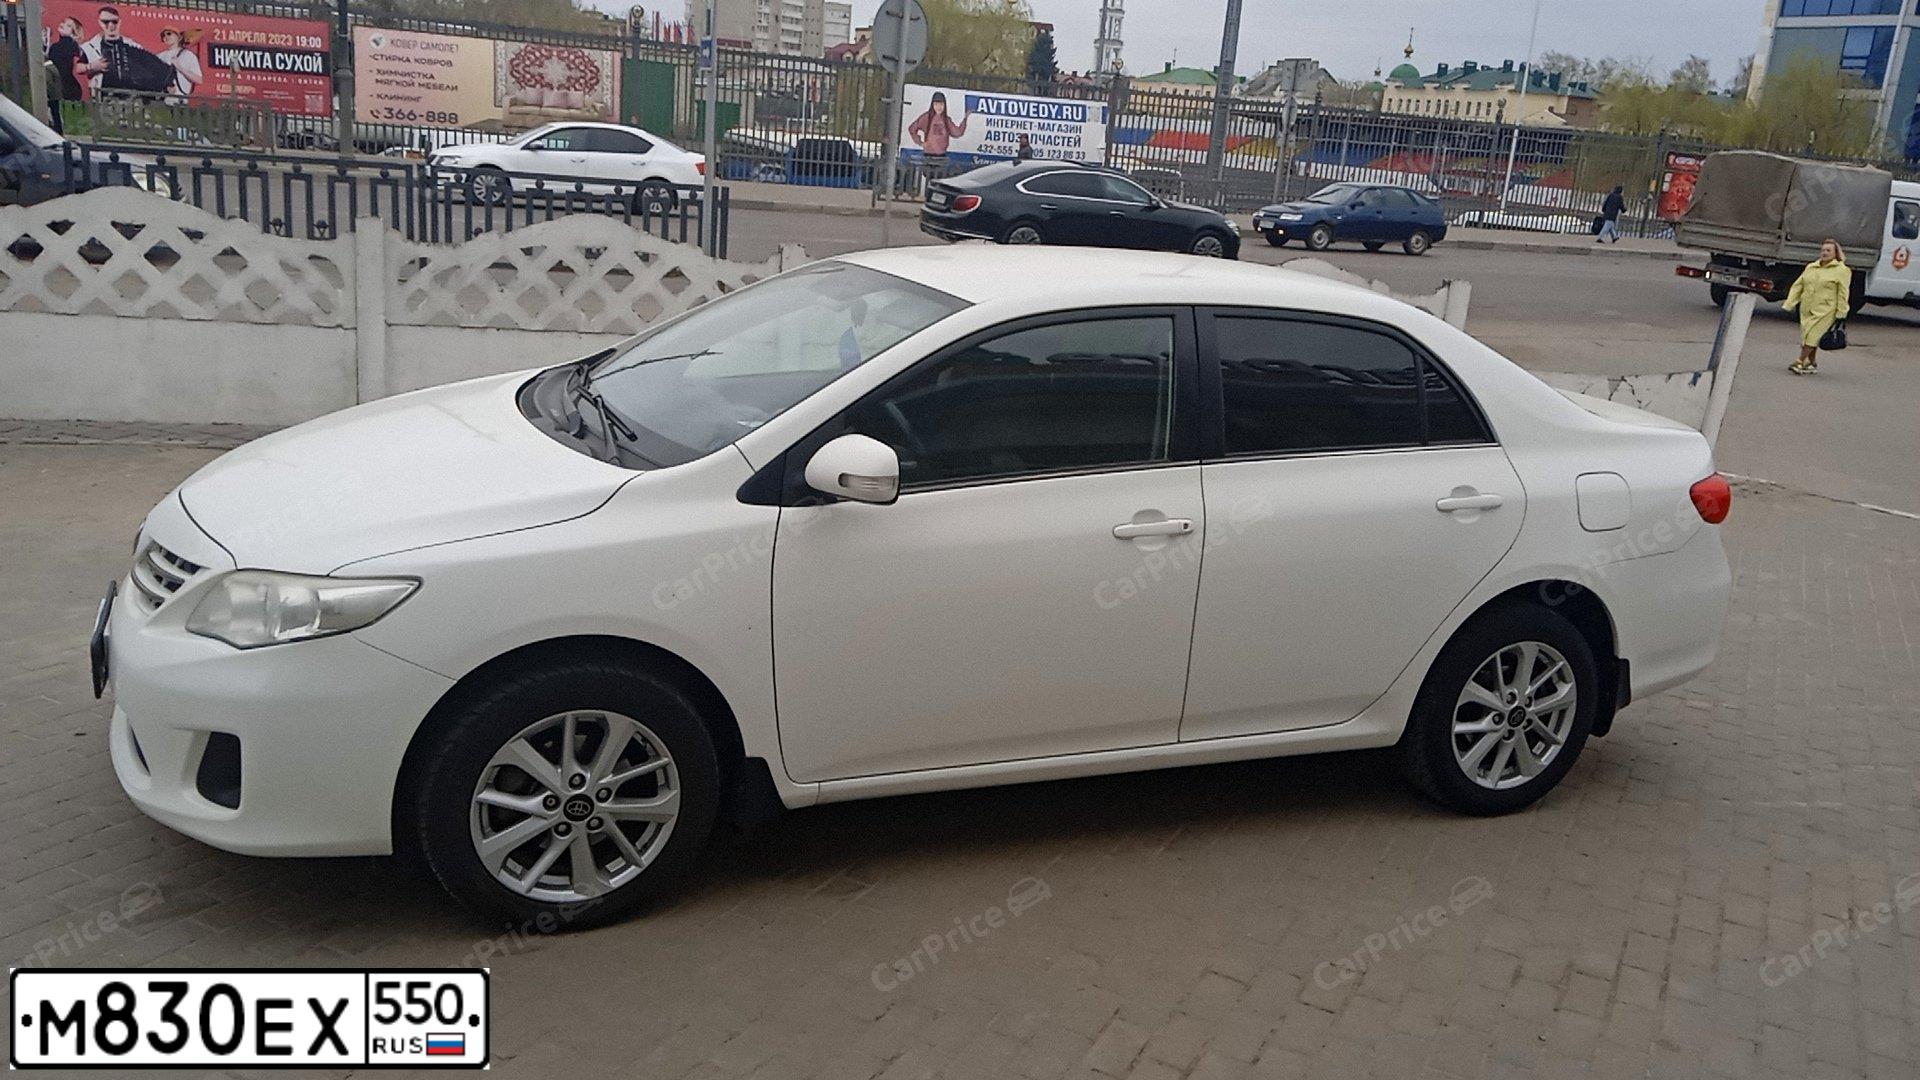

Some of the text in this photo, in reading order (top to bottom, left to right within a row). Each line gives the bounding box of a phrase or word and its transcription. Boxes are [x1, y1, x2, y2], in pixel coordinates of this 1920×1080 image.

[214, 28, 322, 48] 21 АПРЕЛЯ 2023 19:00
[390, 39, 417, 50] КОВЕР
[214, 47, 323, 73] НИКИТА СУХОЙ
[414, 58, 453, 67] КОВРОВ
[376, 69, 435, 80] ХИМЧИСТКА
[375, 78, 459, 91] МЯГКОЙ МЕБЕЛИ
[376, 93, 423, 102] КЛИНИНГ
[383, 107, 459, 125] 366-888
[976, 97, 1082, 120] AVTOVEDY.RU
[985, 118, 1082, 134] ИНТЕРНЕТ-МАГАЗИН
[984, 130, 1082, 148] АВТОЗПЧАСТЕЙ
[976, 144, 1013, 155] 432-555
[1047, 149, 1062, 159] 123
[1075, 151, 1086, 161] 33
